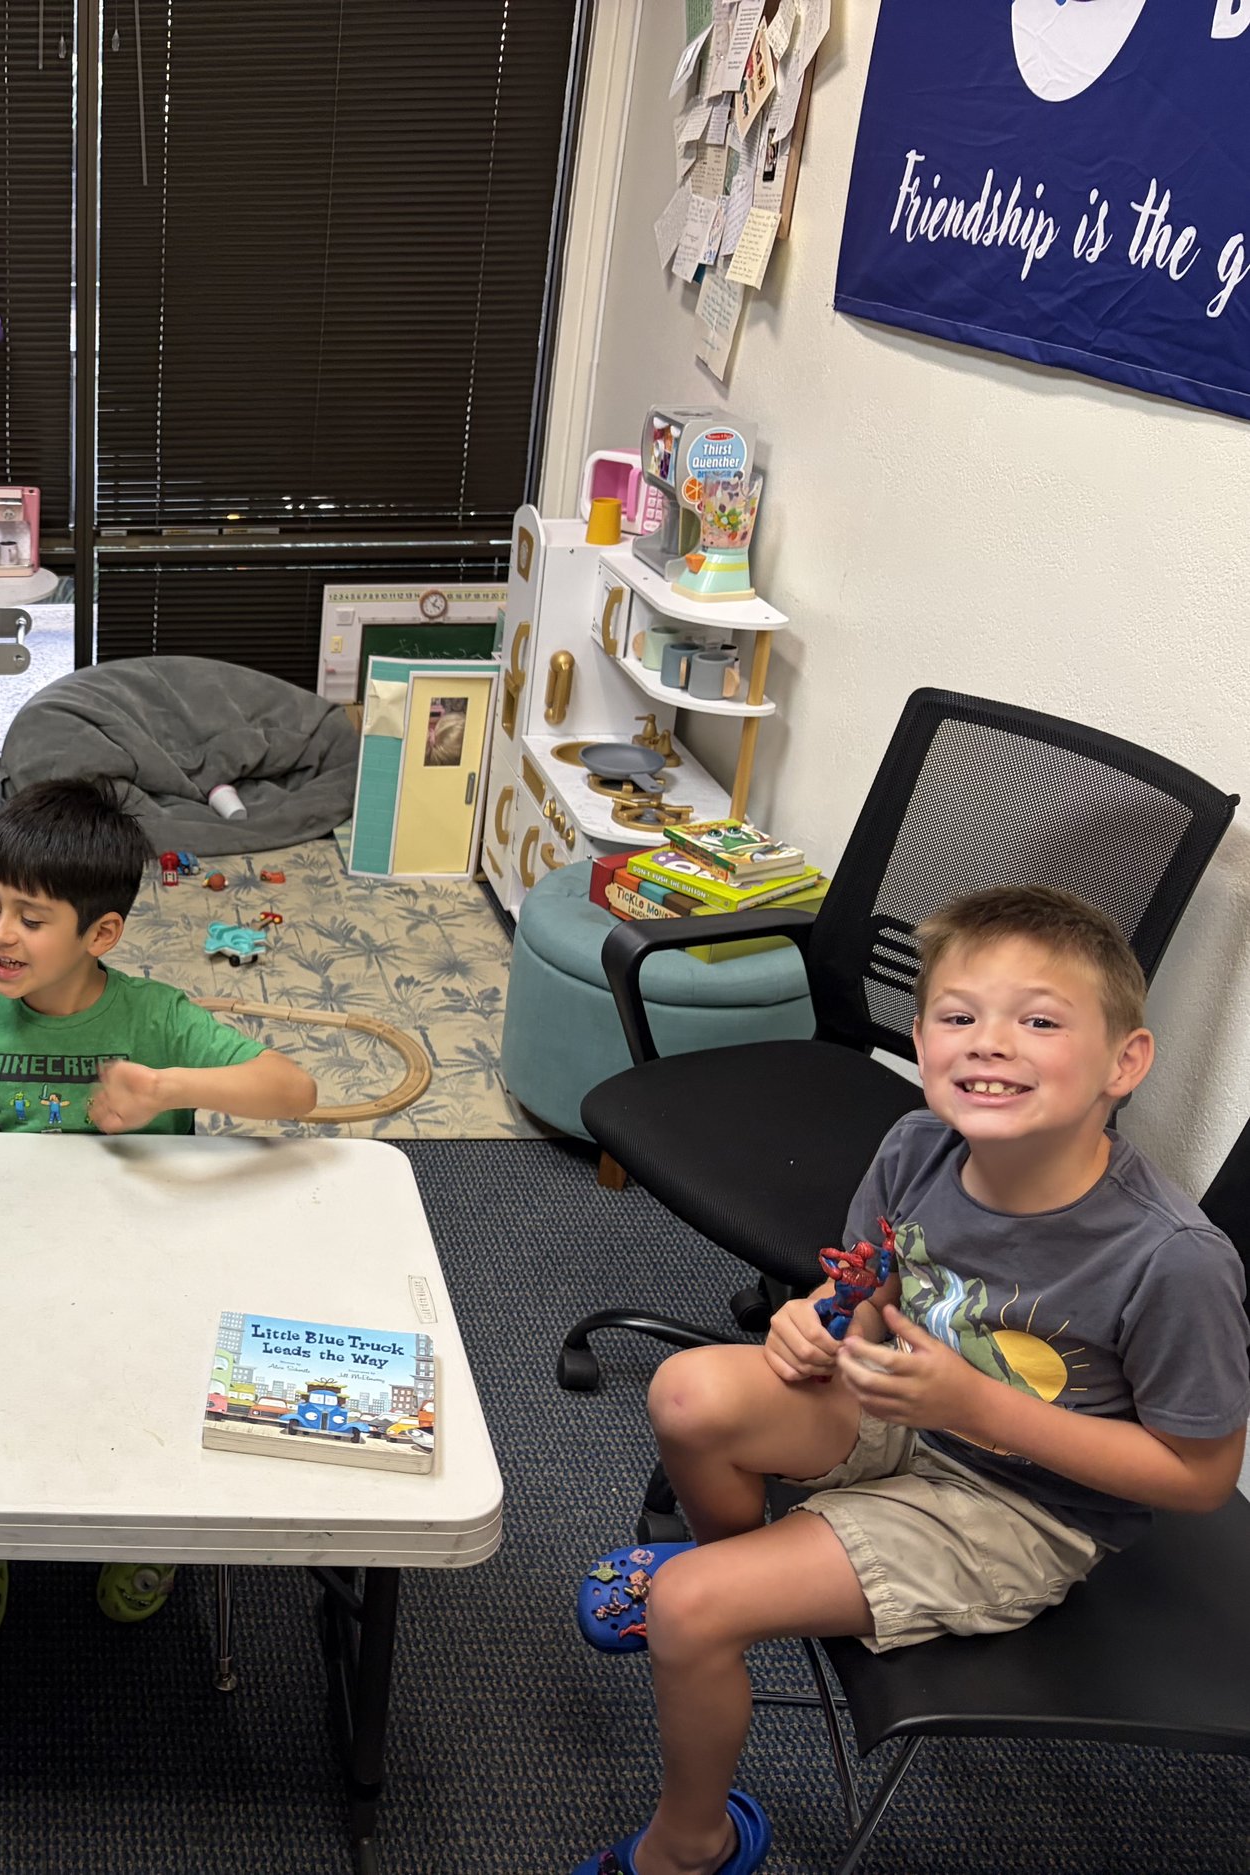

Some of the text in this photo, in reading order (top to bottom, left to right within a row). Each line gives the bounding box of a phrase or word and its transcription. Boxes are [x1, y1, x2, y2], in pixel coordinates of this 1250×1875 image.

[890, 149, 1061, 281] Friendship
[1073, 188, 1113, 263] is
[1127, 177, 1201, 281] the
[692, 456, 740, 468] Quencher
[703, 444, 732, 456] Thirst
[251, 1324, 404, 1356] Little Blue Truck
[262, 1342, 388, 1369] Leads the Way
